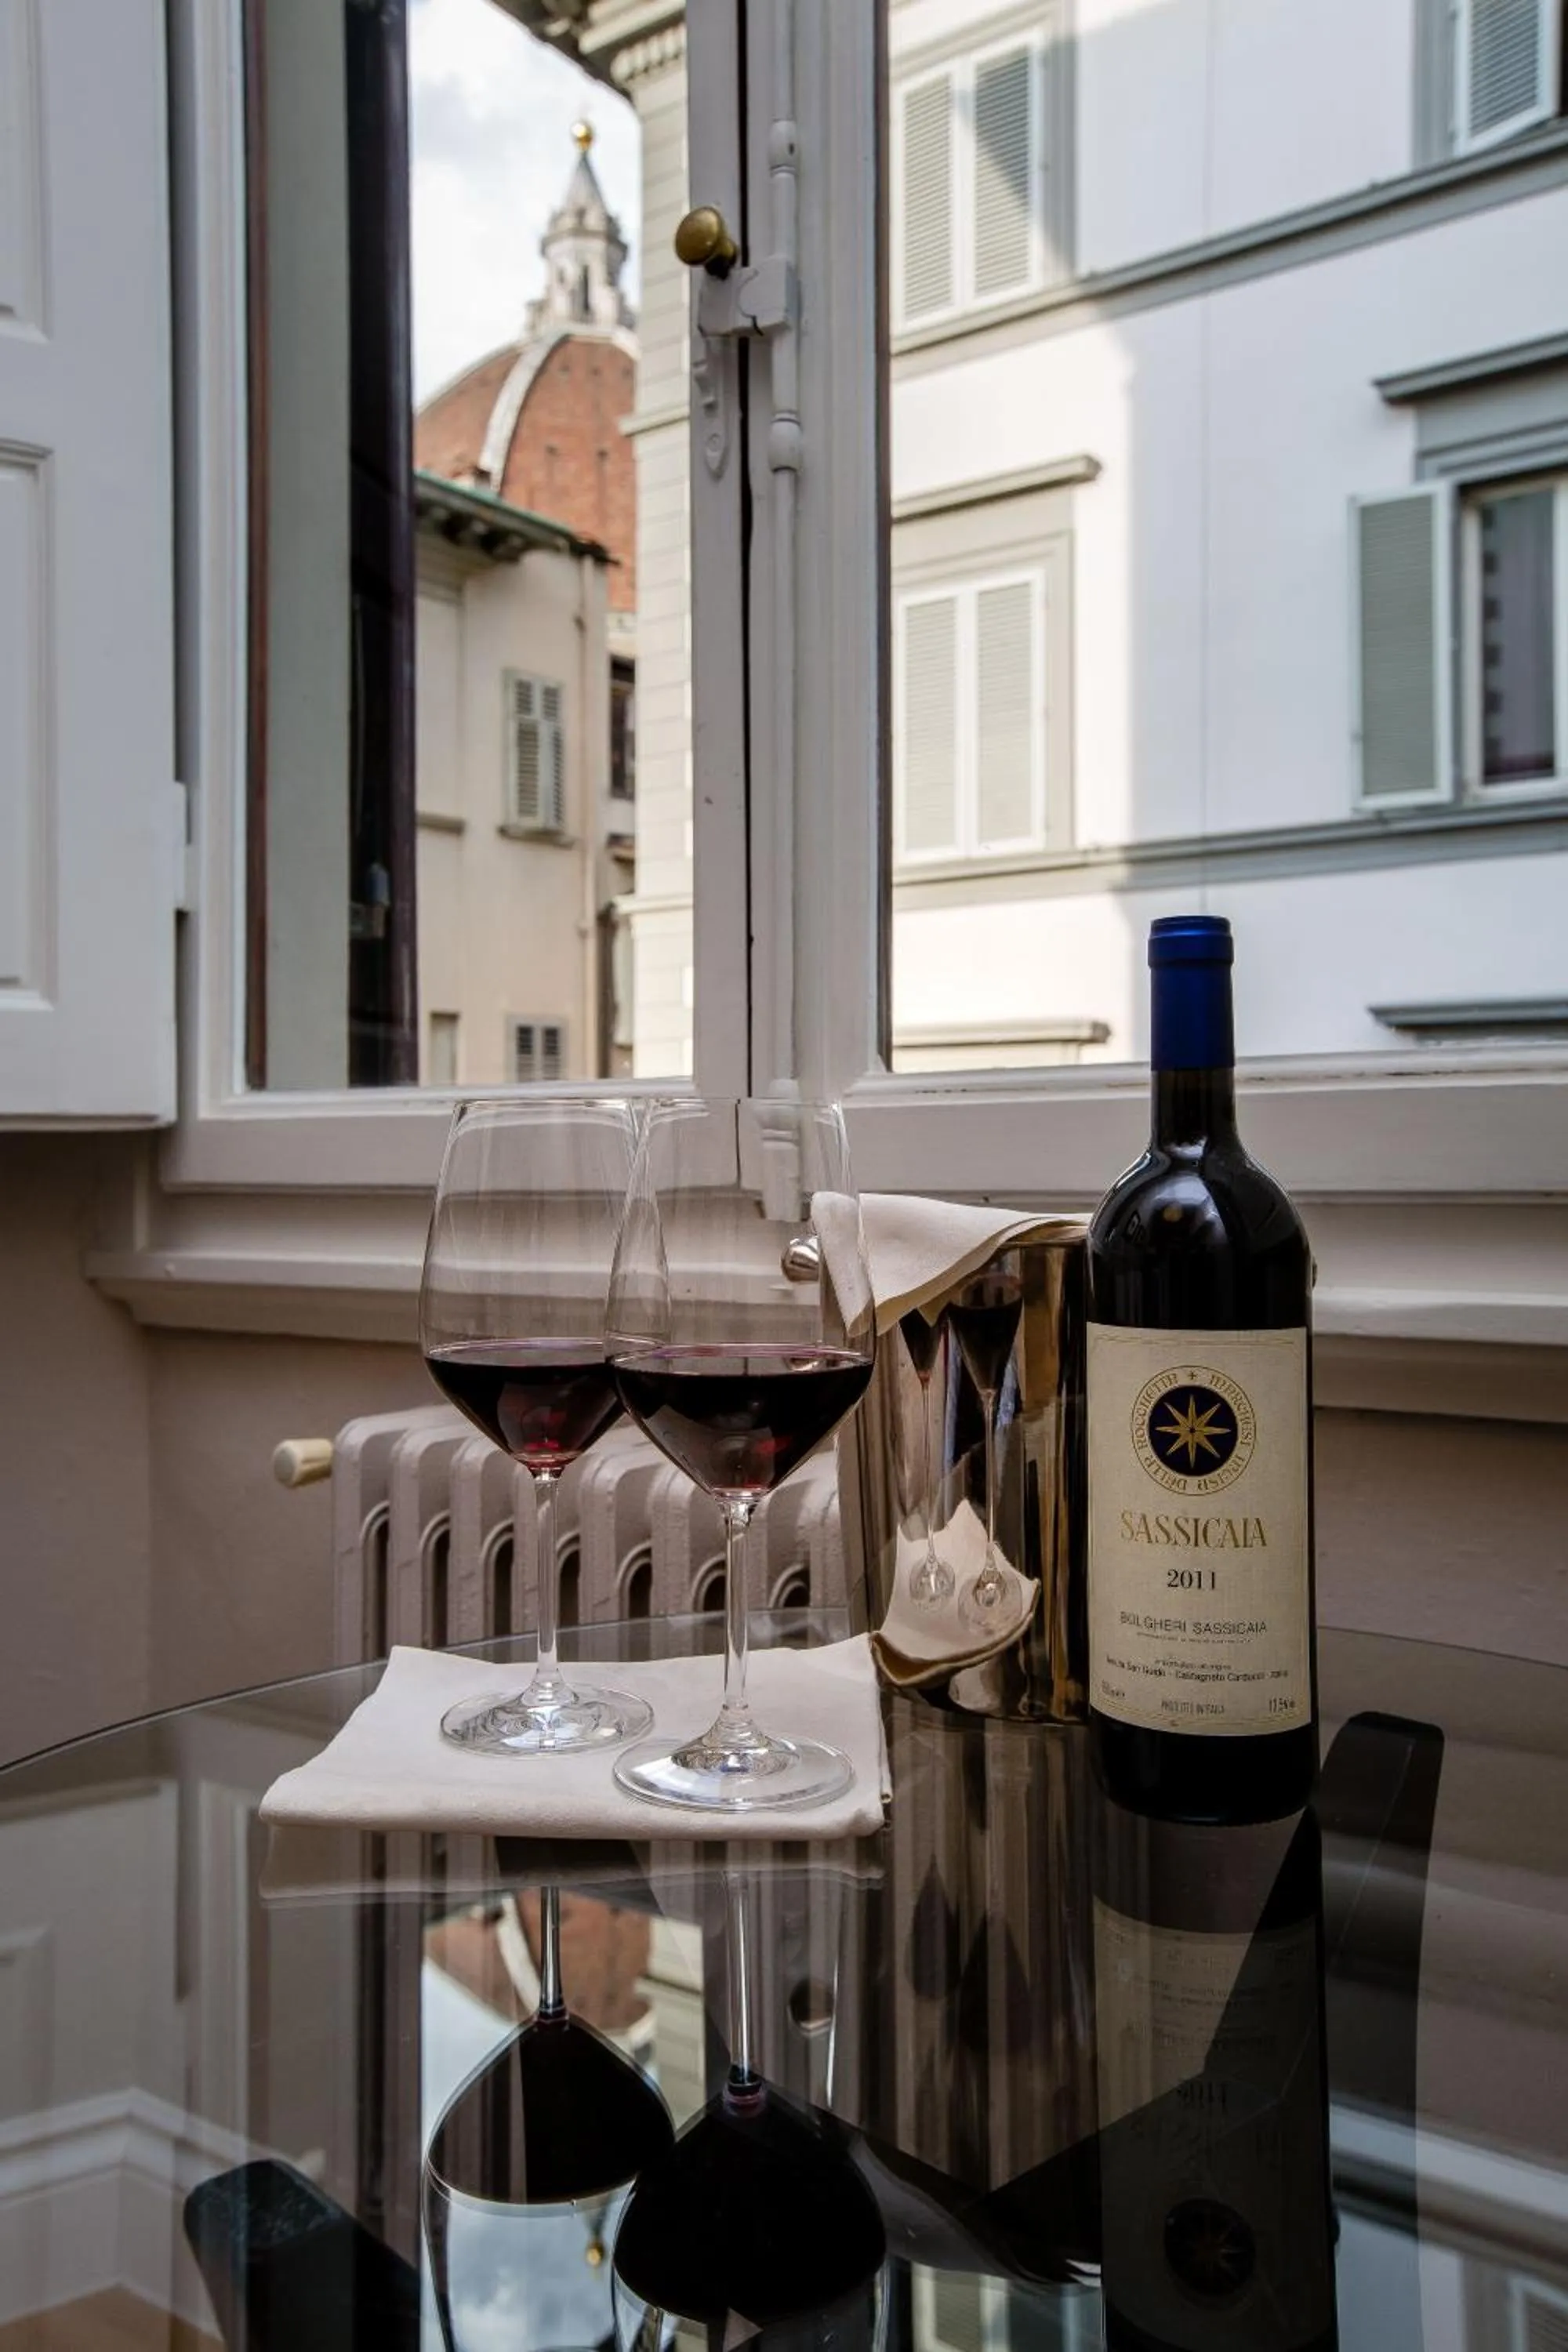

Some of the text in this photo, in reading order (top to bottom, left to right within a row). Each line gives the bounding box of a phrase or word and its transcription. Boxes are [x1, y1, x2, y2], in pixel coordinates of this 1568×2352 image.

[1120, 1510, 1267, 1548] SASSICAIA
[1167, 1569, 1215, 1590] 2011
[1120, 1611, 1267, 1635] BOLGHERI SASSICAIA
